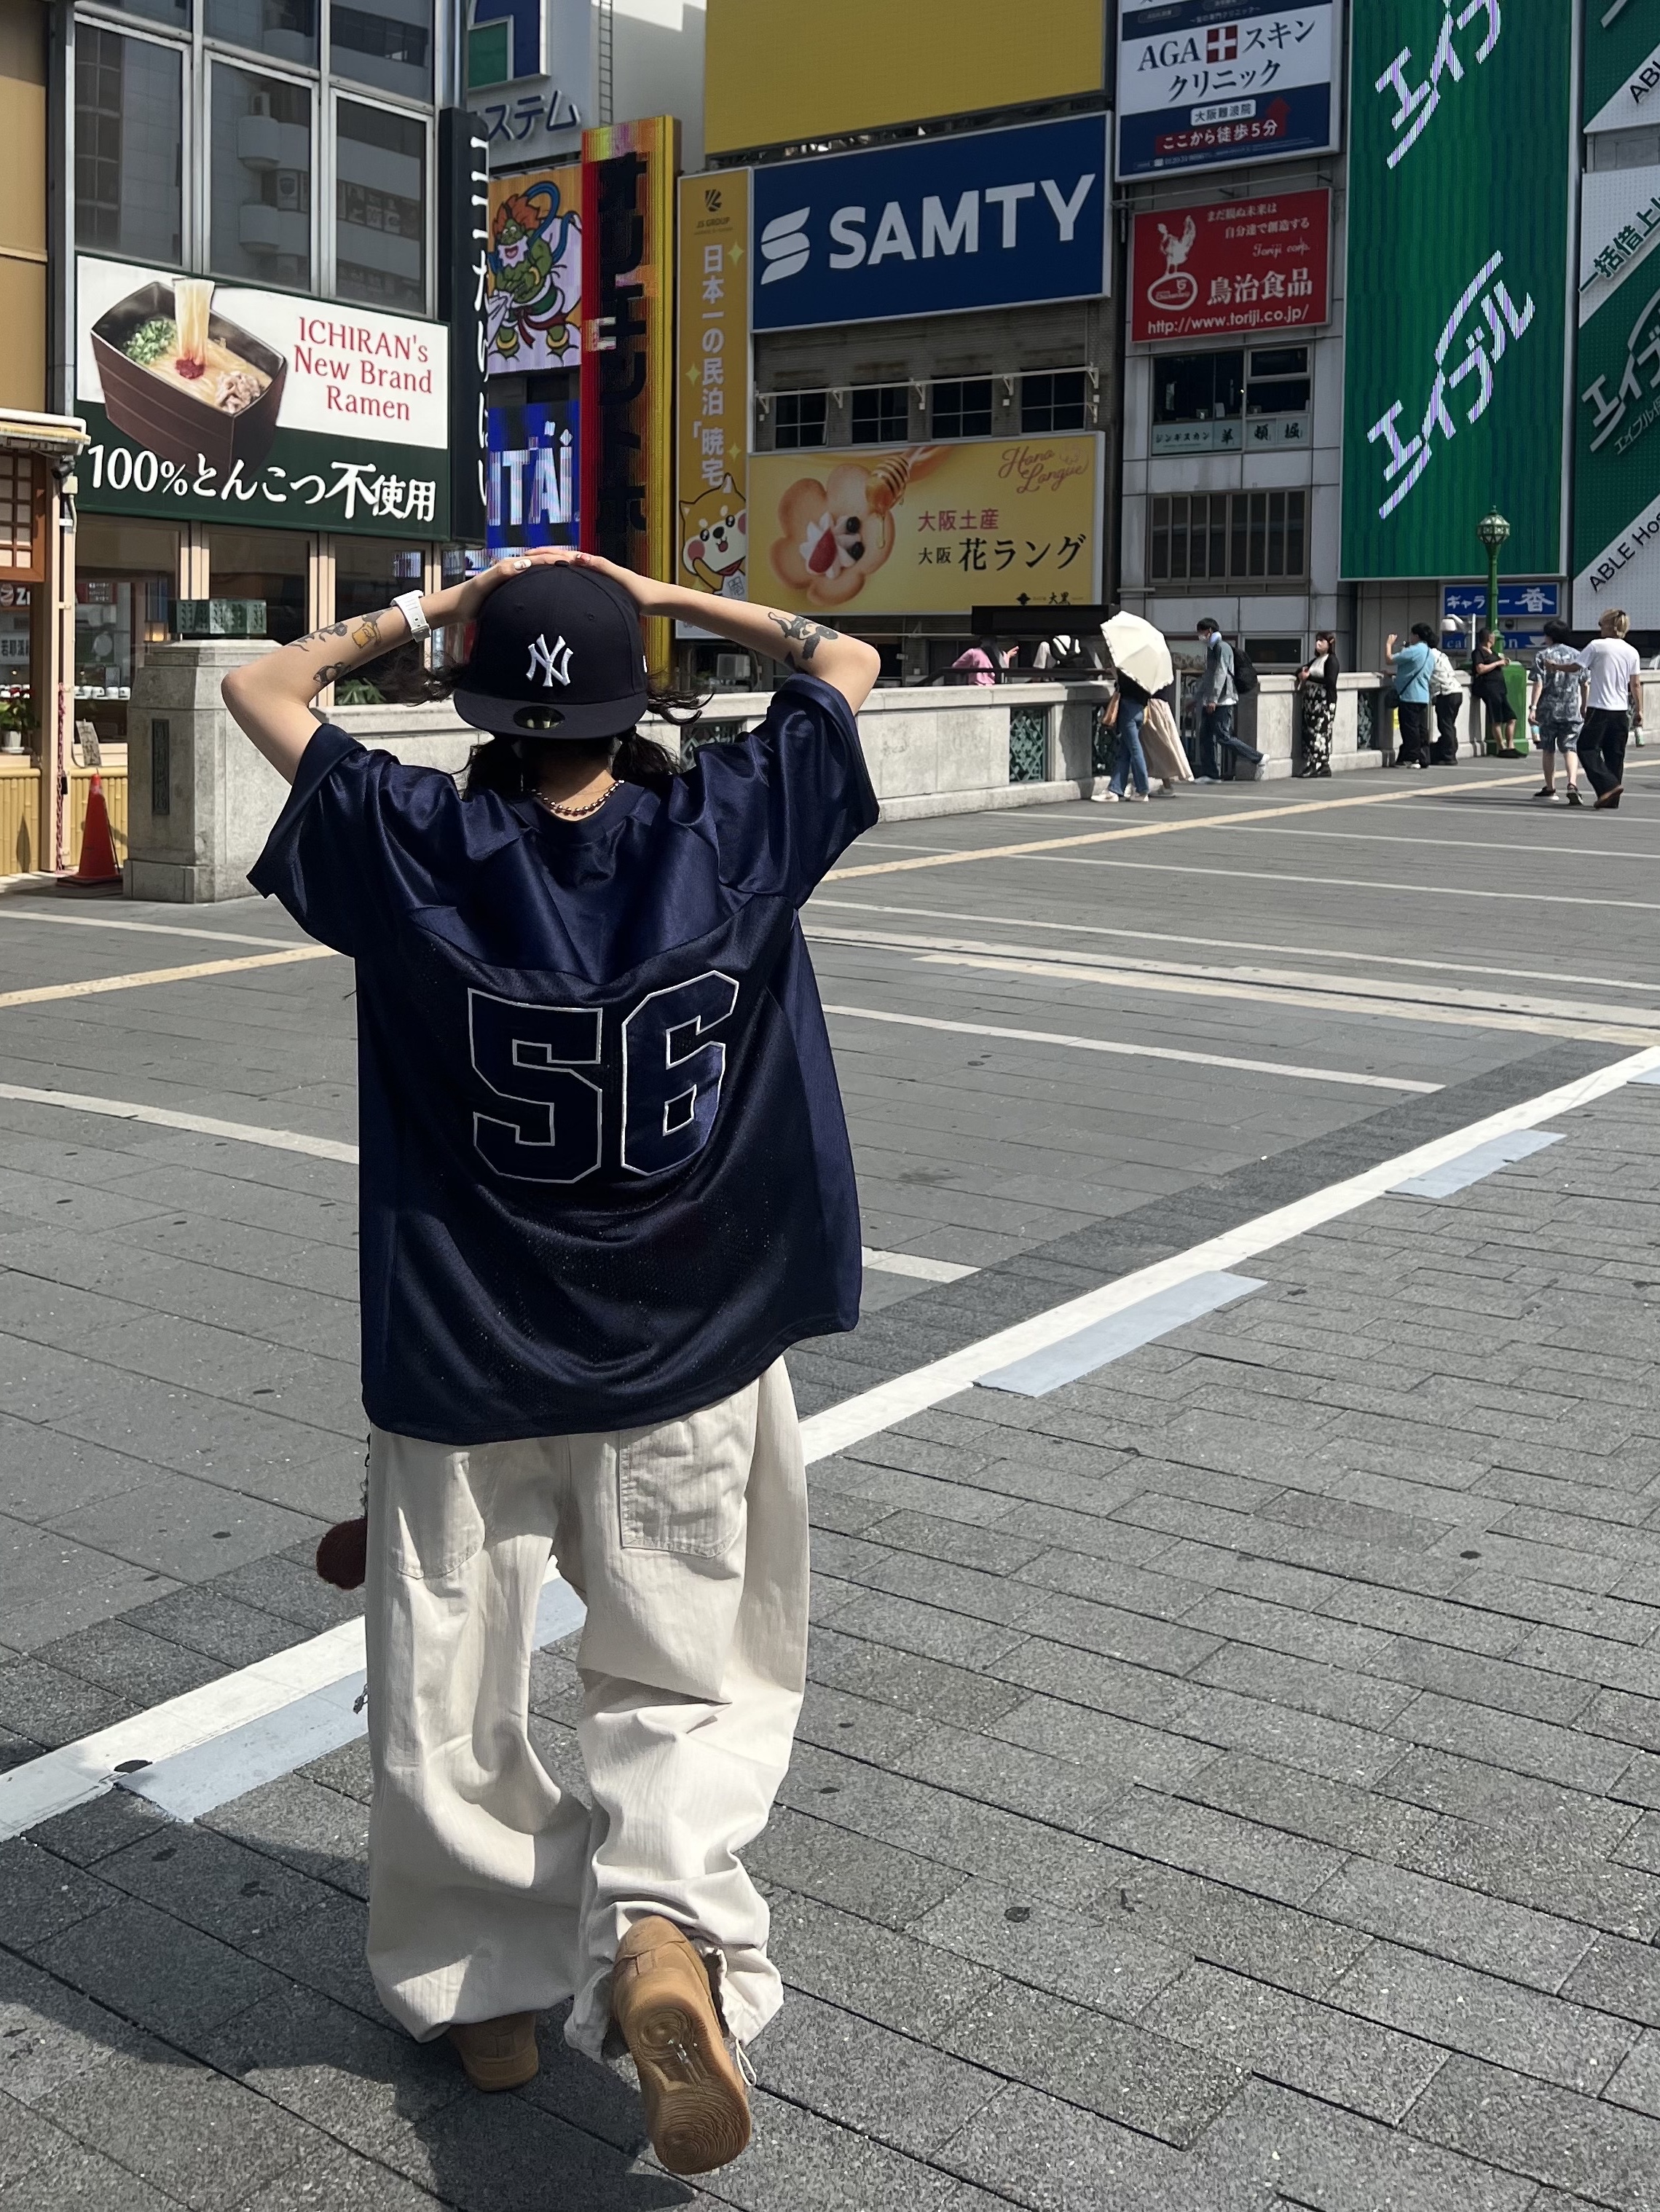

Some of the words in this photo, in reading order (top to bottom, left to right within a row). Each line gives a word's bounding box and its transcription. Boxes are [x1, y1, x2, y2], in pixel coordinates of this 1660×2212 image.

[1137, 37, 1201, 71] AGA
[1243, 20, 1315, 53] スキン
[1169, 58, 1281, 102] クリニック
[472, 89, 581, 140] ステム
[1163, 119, 1278, 150] ここから徒歩5分
[830, 173, 1096, 269] SAMTY
[1207, 267, 1313, 306] 鳥治食品
[299, 317, 428, 363] ICHIRAN's
[1148, 304, 1309, 335] http://www.toriji.co.jp/
[294, 345, 350, 380] New
[361, 360, 432, 393] Brand
[1367, 264, 1535, 503] エイブル
[326, 385, 410, 420] Ramen
[87, 444, 436, 521] 100%とんこつ不使用
[998, 446, 1055, 479] Hana
[918, 508, 999, 532] 大阪土産
[1589, 542, 1635, 592] ABLE
[1447, 587, 1554, 613] ギャラー香
[525, 634, 573, 687] NY
[468, 970, 739, 1184] 56
